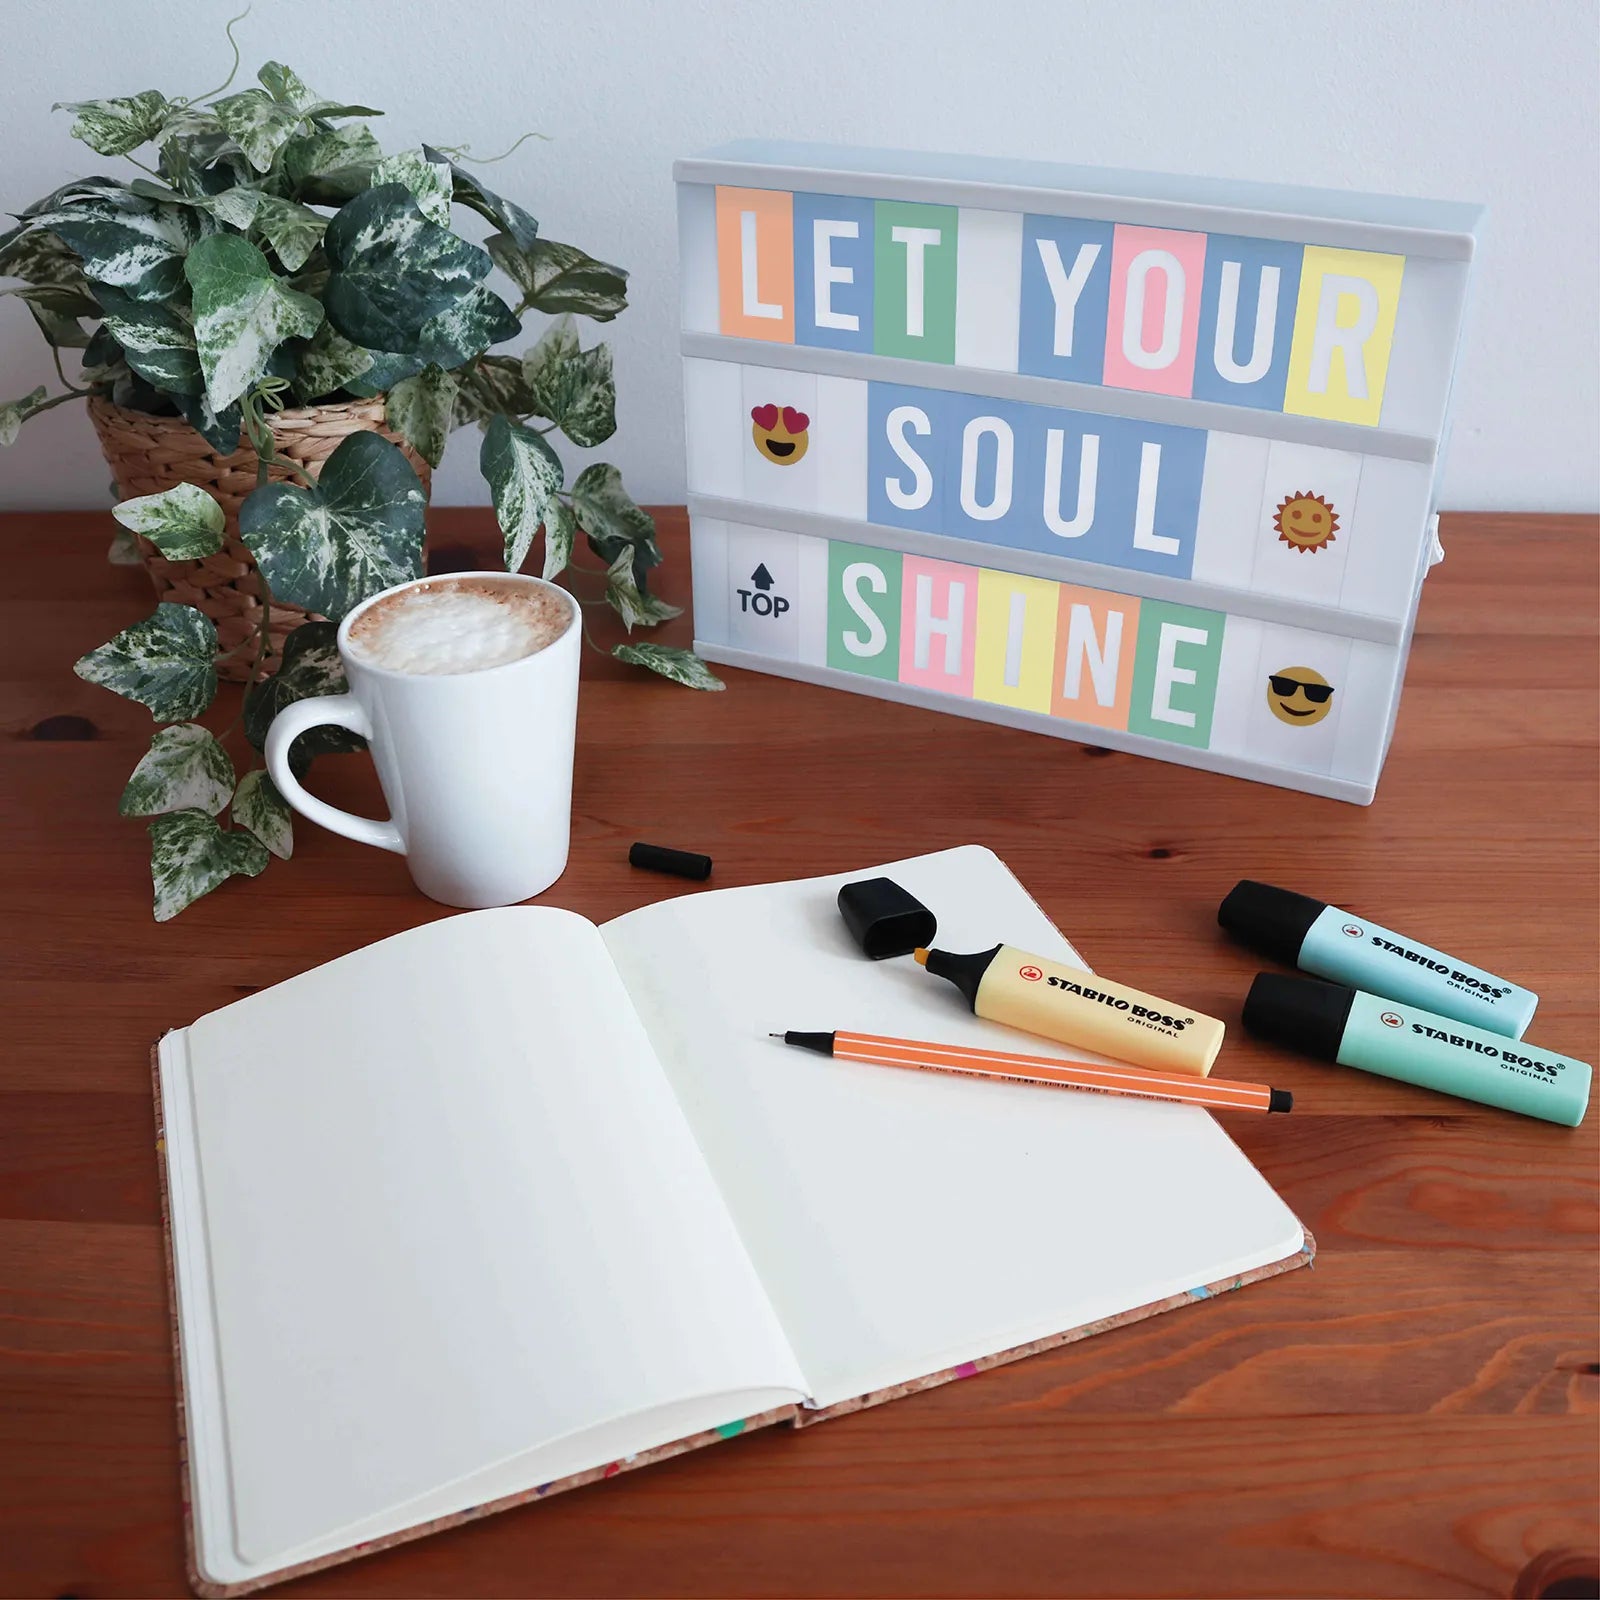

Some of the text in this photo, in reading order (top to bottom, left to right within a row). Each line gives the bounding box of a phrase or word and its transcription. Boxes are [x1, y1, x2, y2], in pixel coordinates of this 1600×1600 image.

[740, 210, 1380, 399] LET YOUR
[883, 405, 1181, 557] SOUL
[736, 588, 790, 619] TOP
[841, 562, 1208, 729] SHINE
[1370, 936, 1450, 975] STABILO
[1046, 976, 1130, 1011] STABILO
[1446, 980, 1497, 1005] ORIGINAL
[1126, 1016, 1179, 1039] ORIGINAL
[1411, 1023, 1499, 1057] STABILO
[1499, 1063, 1556, 1085] ORIGINAL
